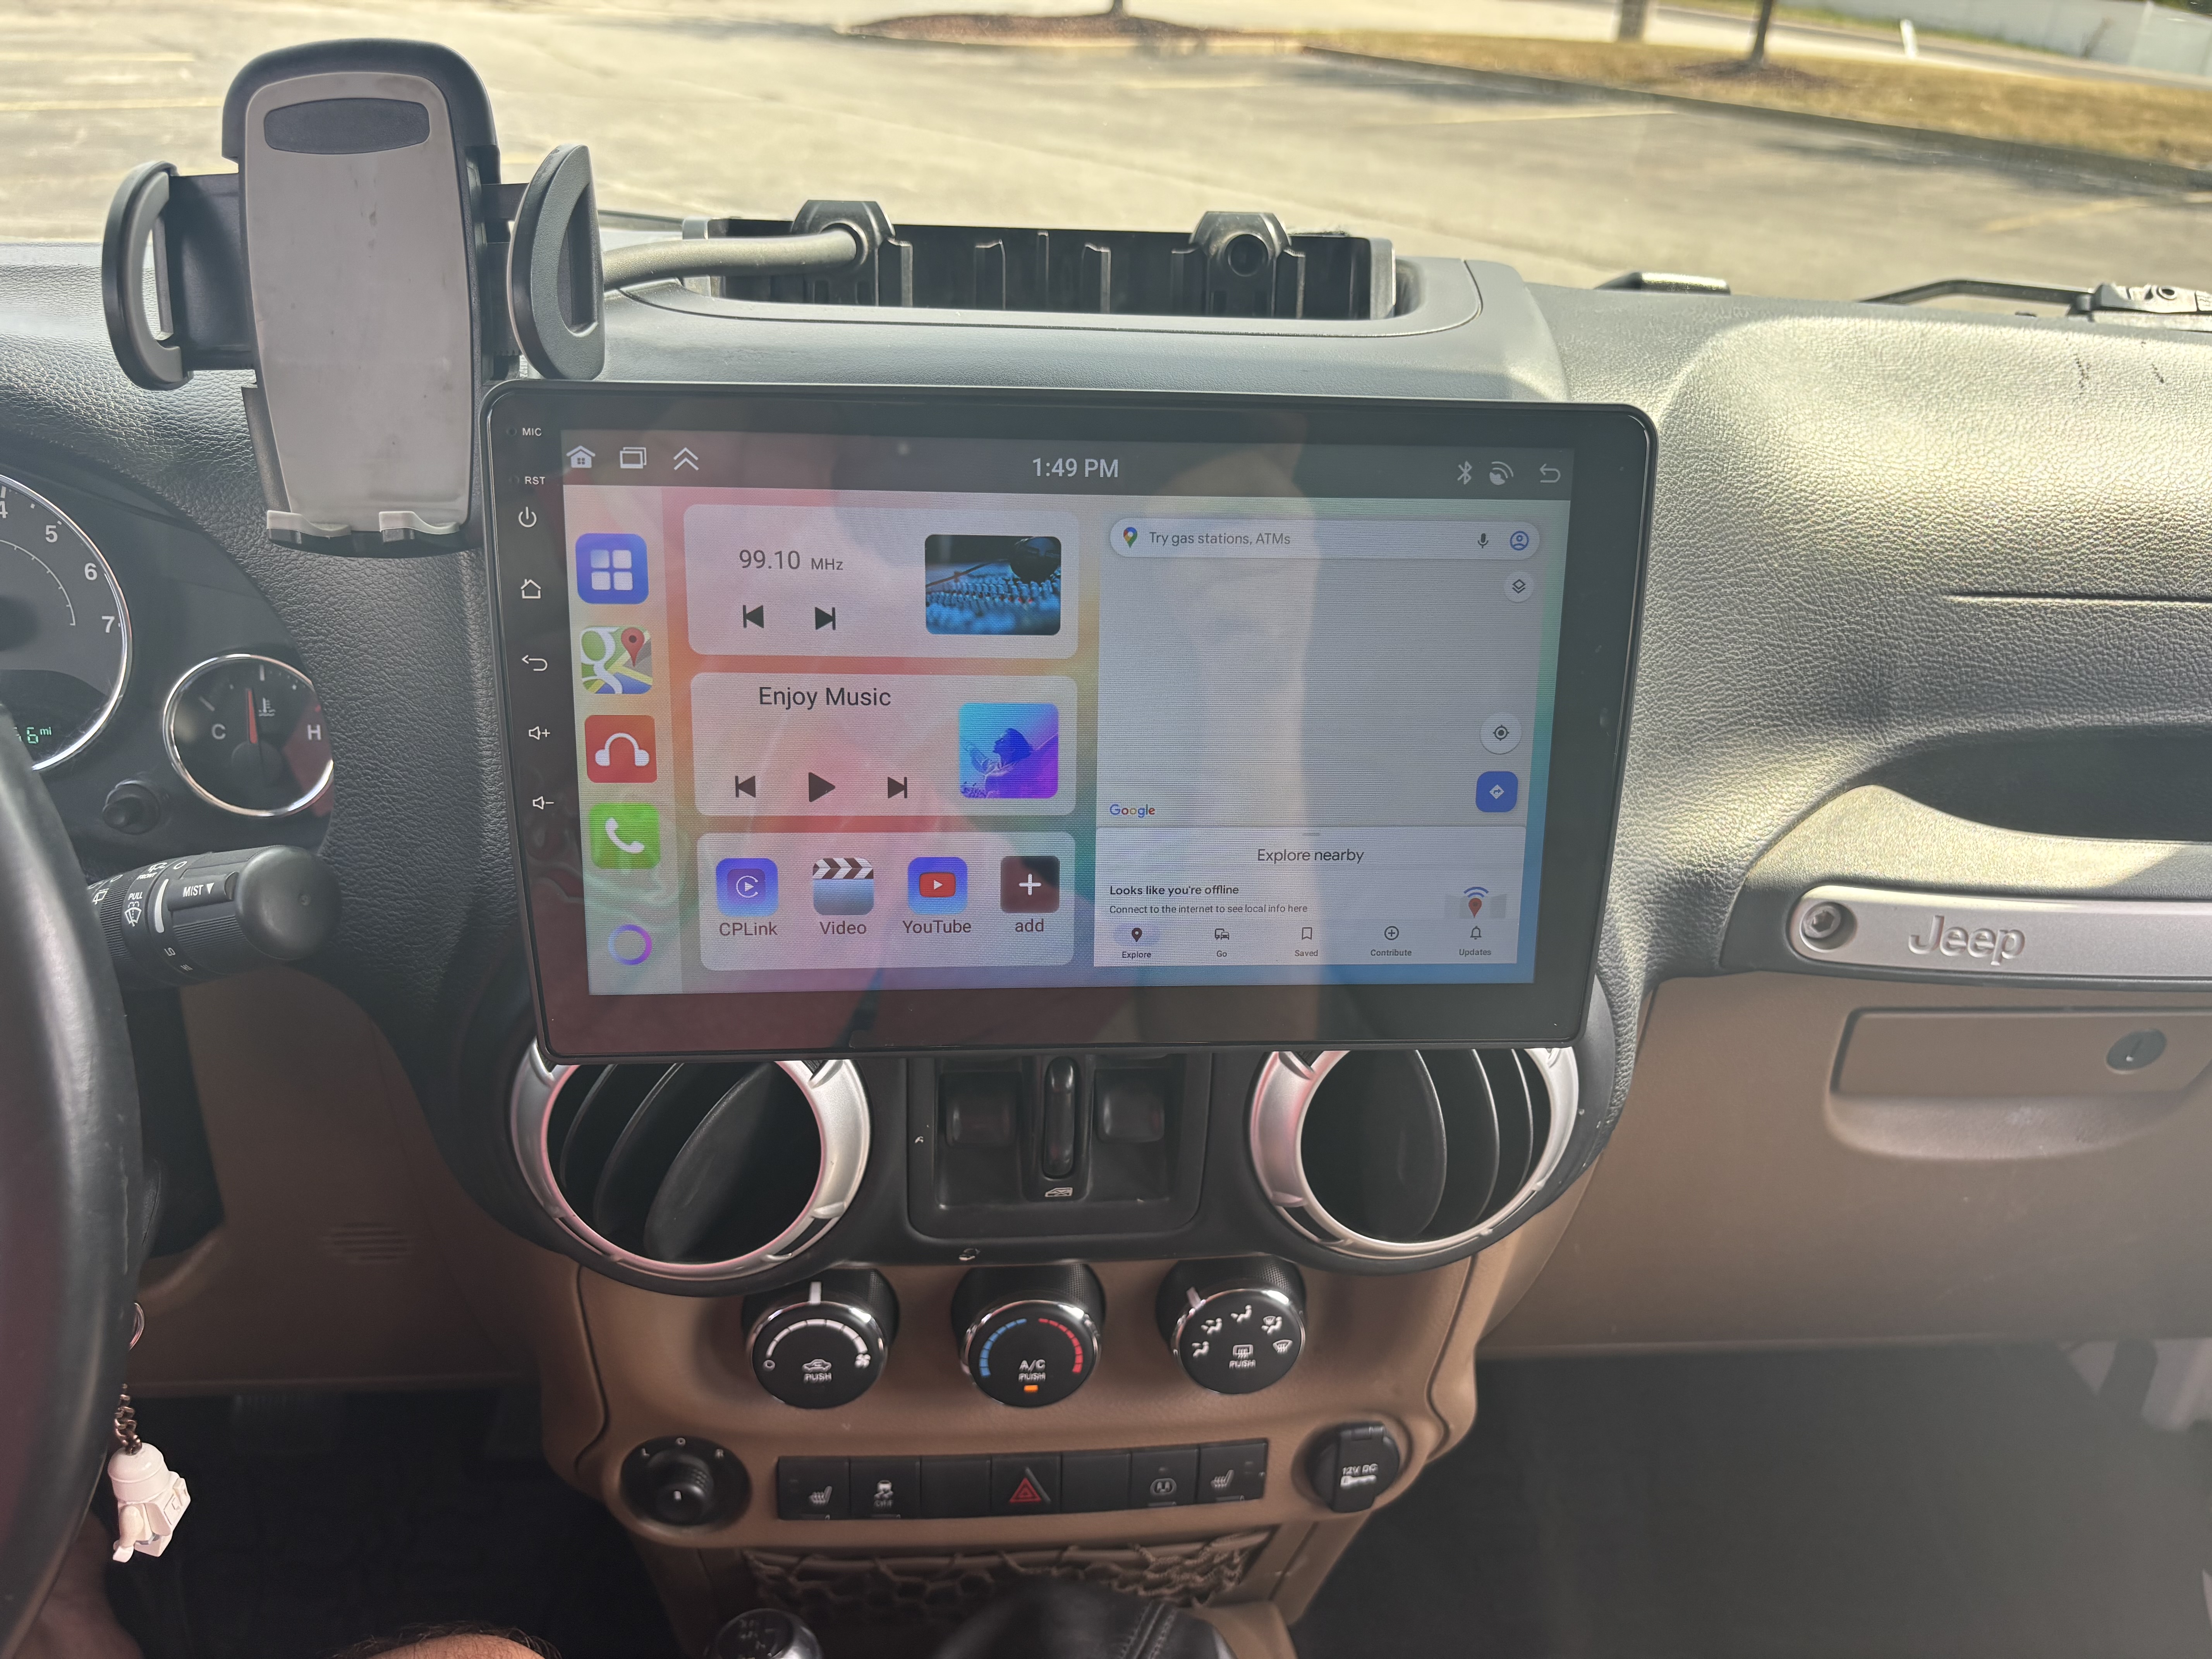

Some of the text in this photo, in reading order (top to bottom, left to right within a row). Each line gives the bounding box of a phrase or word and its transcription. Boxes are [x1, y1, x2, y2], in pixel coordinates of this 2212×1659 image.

[522, 428, 542, 436] MIC
[1033, 458, 1118, 478] 1:49 PM
[525, 476, 545, 485] RST
[45, 524, 58, 543] 5
[1149, 532, 1291, 546] Try gas stations, ATMs
[739, 549, 844, 571] 99.10 MHz
[84, 563, 98, 581] 6
[101, 615, 115, 634] 7
[759, 687, 891, 710] Enjoy Music
[211, 724, 227, 740] C
[307, 725, 321, 740] H
[1109, 804, 1155, 818] Google
[1257, 848, 1364, 864] Explore nearby
[136, 872, 158, 880] FRONT
[128, 892, 143, 901] PULL
[183, 884, 204, 898] MIST
[1110, 885, 1239, 897] Looks like you're offline
[1109, 905, 1147, 914] Connect
[1162, 905, 1176, 913] the
[1178, 905, 1213, 913] internet
[1245, 905, 1266, 913] local
[1268, 904, 1285, 913] info
[1288, 904, 1308, 912] here
[718, 921, 778, 937] CPLink
[819, 921, 867, 935] Video
[902, 919, 972, 934] YouTube
[1015, 918, 1044, 933] add
[1908, 915, 2026, 966] Jeep
[164, 947, 176, 956] LO
[1122, 951, 1152, 959] Explore
[1459, 948, 1491, 957] Updates
[1019, 1359, 1046, 1372] A/C
[1229, 1360, 1256, 1369] PUSH
[804, 1372, 832, 1382] PUSH
[1018, 1372, 1046, 1382] PUSH
